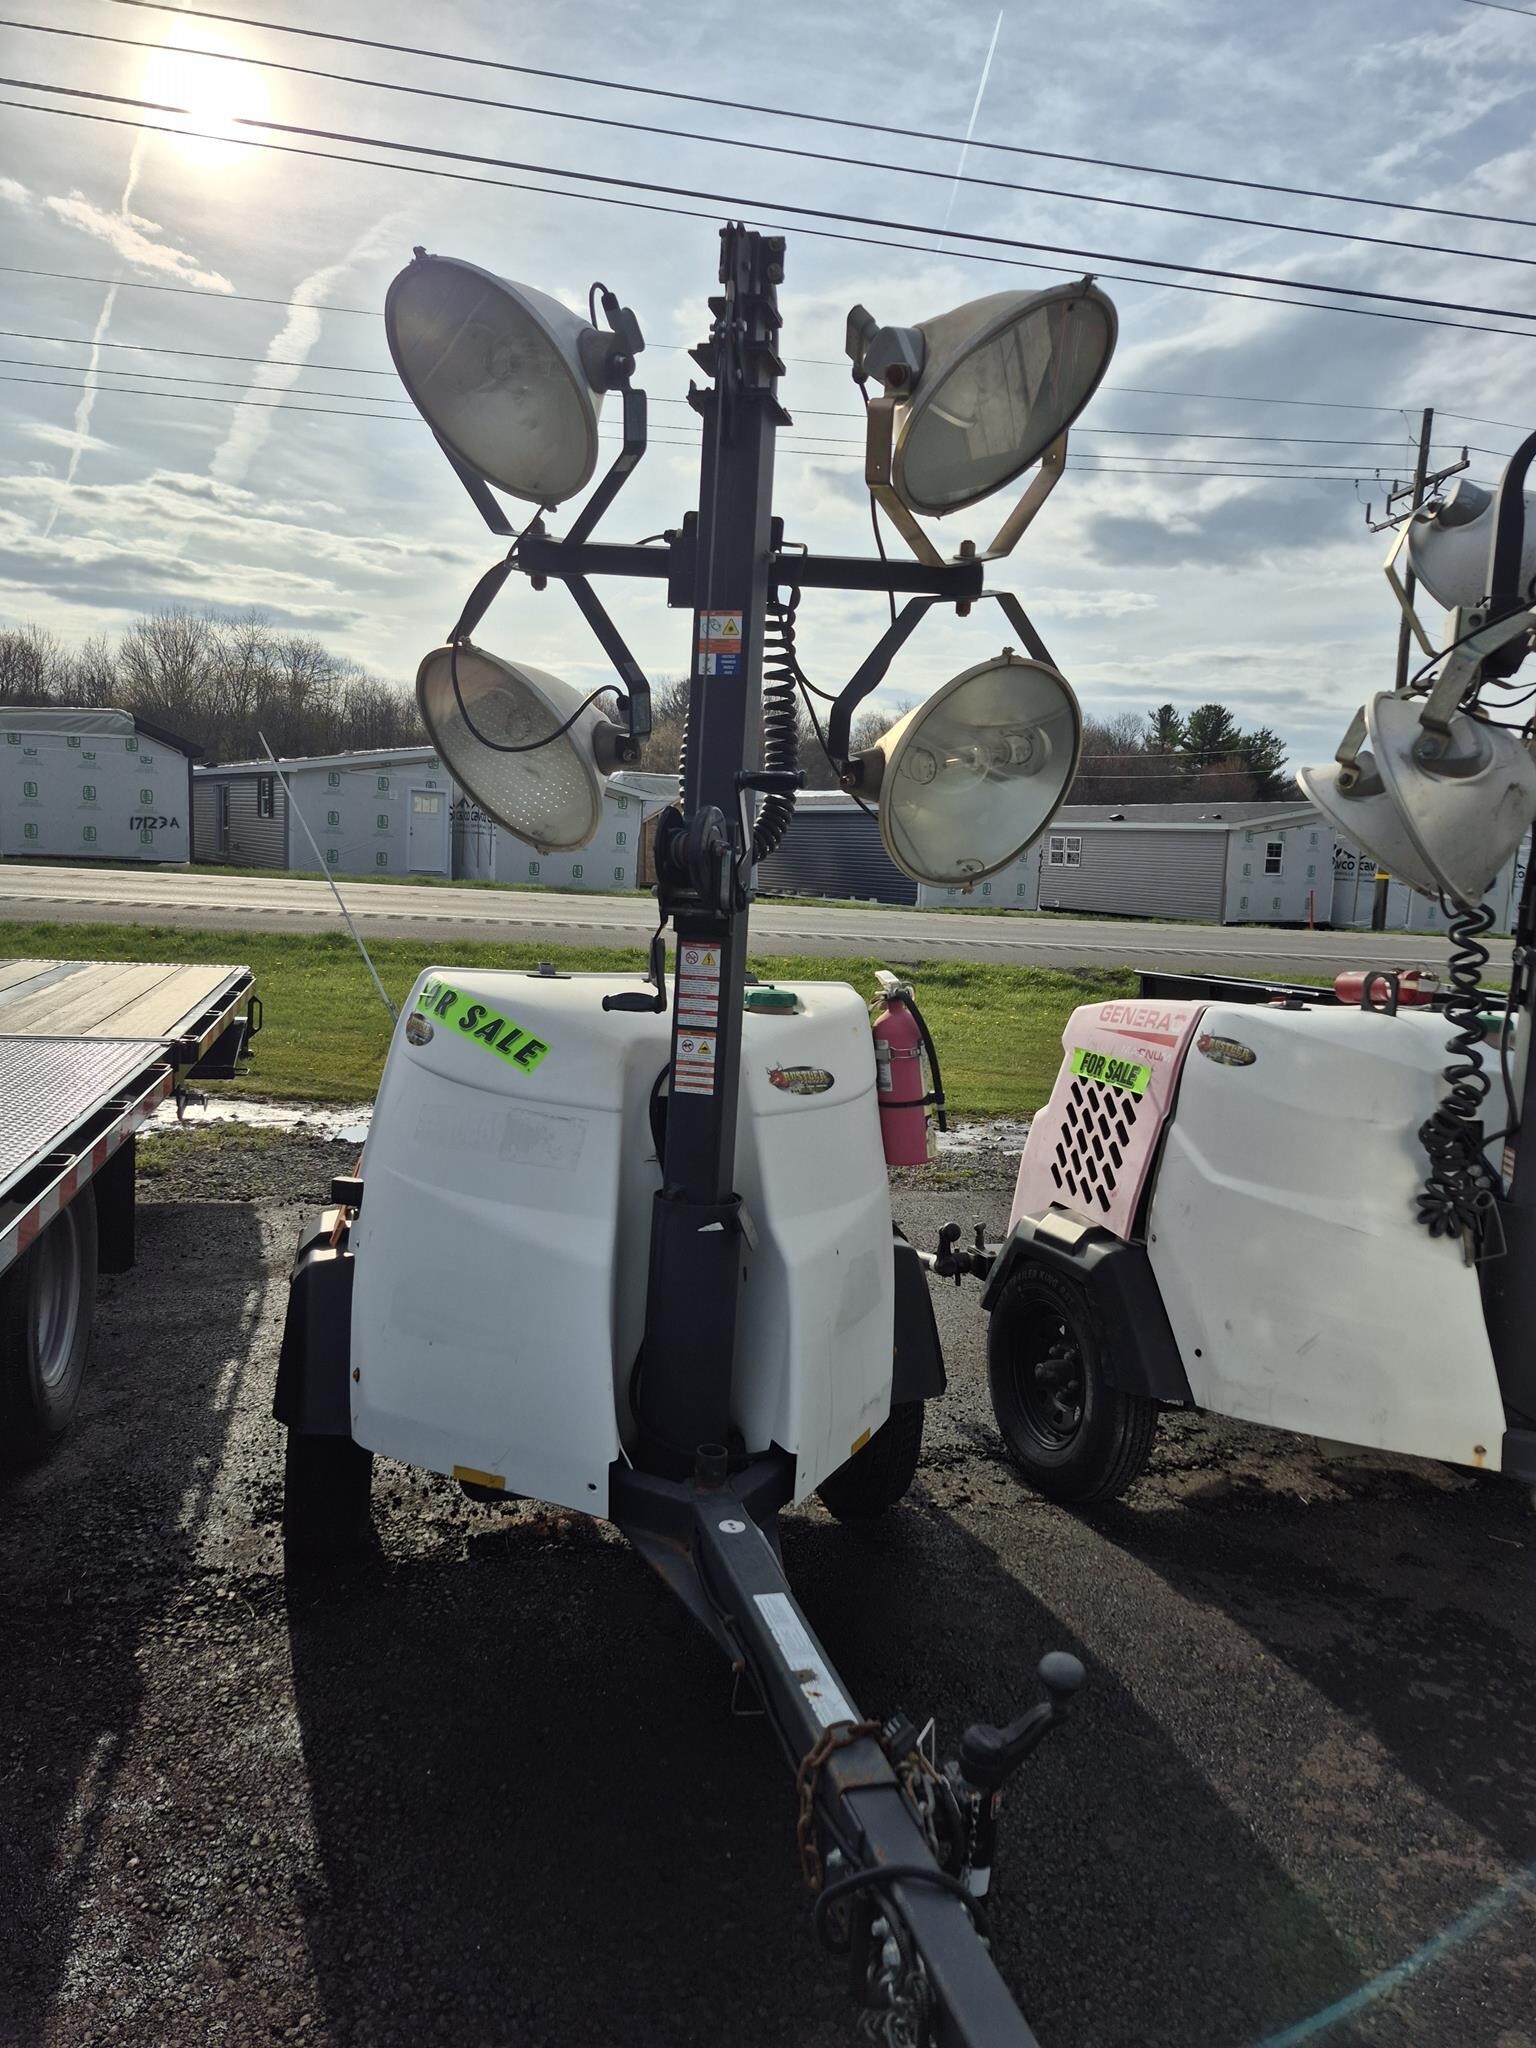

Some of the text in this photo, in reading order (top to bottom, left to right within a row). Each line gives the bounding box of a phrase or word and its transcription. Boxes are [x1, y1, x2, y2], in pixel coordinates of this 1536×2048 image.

[458, 1005, 548, 1066] SALE
[1080, 1051, 1141, 1087] FOR SALE
